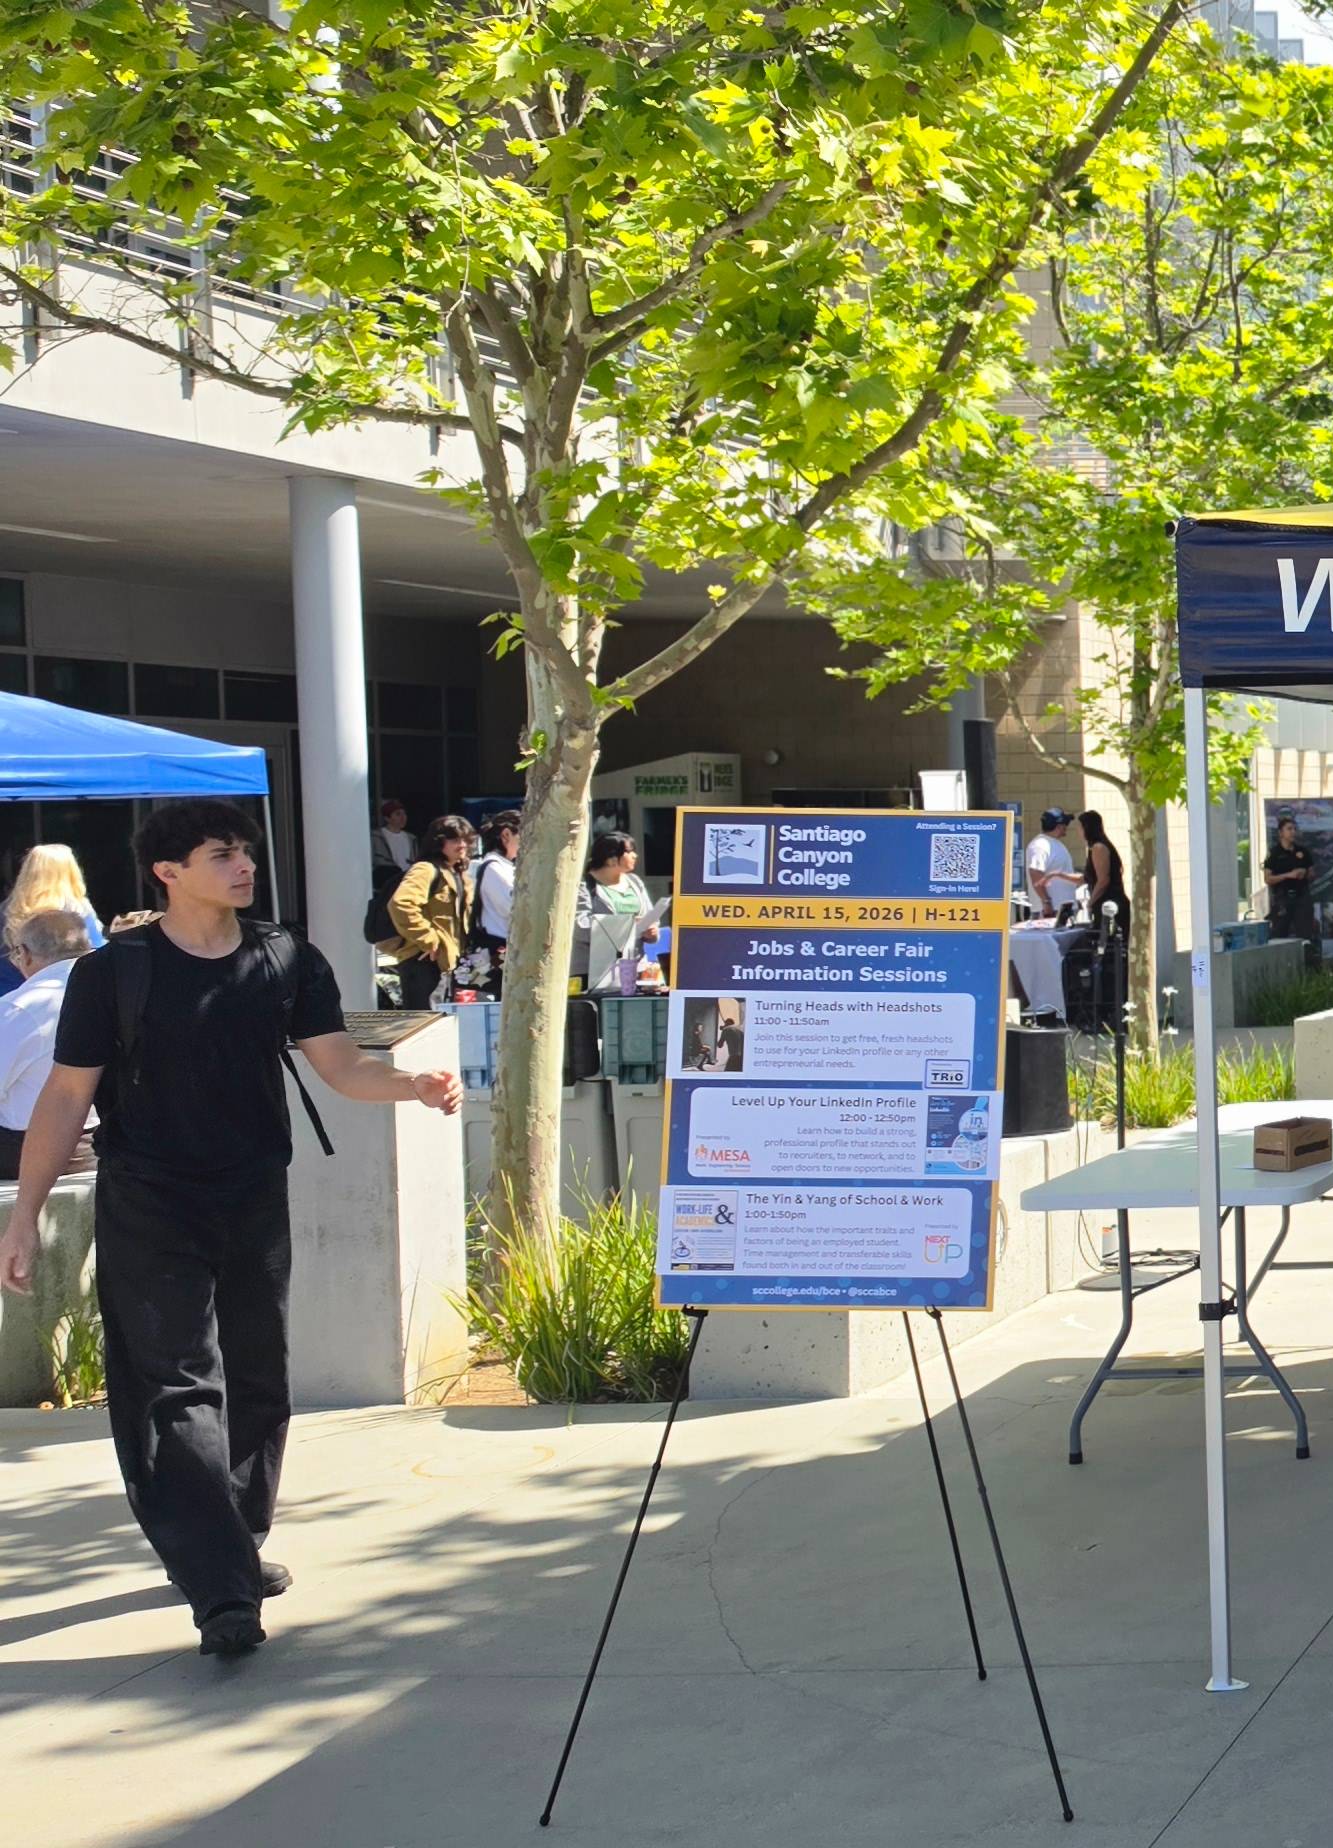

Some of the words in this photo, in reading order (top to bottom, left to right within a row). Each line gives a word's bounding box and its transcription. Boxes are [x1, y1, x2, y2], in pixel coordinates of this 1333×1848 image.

[635, 786, 688, 795] FRIDGE
[916, 822, 956, 832] Attending
[962, 823, 997, 831] Session?
[779, 825, 866, 846] Santiago
[779, 848, 853, 867] Canyon
[777, 869, 850, 890] College
[703, 905, 751, 919] WED.
[758, 906, 815, 919] APRIL
[823, 907, 851, 922] 15,
[858, 907, 903, 921] 2026
[925, 908, 980, 921] H-121
[748, 941, 794, 956] Jobs
[800, 941, 815, 957] &
[821, 942, 889, 957] Career
[894, 942, 933, 957] Fair
[732, 965, 853, 981] Information
[859, 966, 947, 982] Sessions
[756, 1000, 802, 1013] Turning
[806, 1001, 844, 1011] Heads
[847, 1001, 873, 1012] with
[877, 1002, 943, 1013] Headshots
[754, 1017, 781, 1025] 11:00
[789, 1017, 829, 1026] 11:50am
[754, 1034, 774, 1042] Join
[776, 1034, 793, 1042] this
[795, 1034, 828, 1043] session
[830, 1035, 840, 1043] to
[842, 1036, 857, 1045] get
[859, 1034, 880, 1044] free,
[881, 1035, 904, 1043] fresh
[907, 1035, 953, 1044] headshots
[754, 1047, 764, 1055] to
[784, 1047, 798, 1055] for
[799, 1048, 820, 1057] your
[862, 1047, 892, 1057] profile
[905, 1049, 922, 1058] any
[924, 1048, 948, 1057] other
[754, 1059, 824, 1069] entrepreneurial
[826, 1060, 855, 1068] needs.
[732, 1096, 764, 1106] Level
[769, 1097, 785, 1109] Up
[789, 1097, 816, 1107] Your
[876, 1098, 917, 1108] Profile
[840, 1114, 866, 1122] 12:00
[875, 1114, 916, 1124] 12:50pm
[797, 1127, 821, 1135] Learn
[824, 1127, 842, 1135] how
[856, 1127, 877, 1136] build
[886, 1128, 916, 1137] strong,
[764, 1139, 819, 1148] professional
[820, 1139, 849, 1149] profile
[850, 1140, 869, 1148] that
[870, 1140, 900, 1148] stands
[901, 1140, 916, 1148] out
[710, 1150, 751, 1162] MESA
[779, 1151, 788, 1159] to
[790, 1152, 835, 1161] recruiters,
[837, 1152, 846, 1160] to
[848, 1152, 885, 1161] network,
[887, 1152, 905, 1160] and
[771, 1166, 793, 1174] open
[795, 1164, 820, 1173] doors
[854, 1165, 914, 1175] opportunities.
[746, 1194, 768, 1205] The
[772, 1194, 792, 1205] Yin
[795, 1194, 803, 1205] &
[807, 1194, 837, 1208] Yang
[839, 1194, 853, 1205] of
[855, 1194, 897, 1206] School
[900, 1195, 909, 1206] &
[912, 1195, 944, 1206] Work
[676, 1204, 712, 1215] WORK-LIFE
[715, 1204, 735, 1225] &
[745, 1210, 807, 1221] 1:00-1:50pm
[744, 1225, 768, 1234] Learn
[770, 1225, 792, 1234] about
[795, 1225, 813, 1234] how
[815, 1226, 830, 1234] the
[832, 1226, 873, 1236] important
[875, 1226, 897, 1235] traits
[899, 1226, 915, 1235] and
[744, 1237, 774, 1246] factors
[776, 1237, 785, 1246] of
[786, 1238, 809, 1248] being
[823, 1238, 865, 1248] employed
[925, 1235, 951, 1244] NEXT
[744, 1249, 764, 1258] Time
[766, 1250, 820, 1260] management
[825, 1250, 838, 1258] and
[840, 1250, 890, 1259] transferable
[891, 1250, 912, 1259] skills
[924, 1243, 963, 1264] UP
[743, 1261, 767, 1270] found
[769, 1261, 789, 1270] both
[791, 1262, 799, 1270] in
[801, 1262, 816, 1270] and
[818, 1263, 832, 1271] out
[834, 1262, 845, 1271] of
[847, 1262, 860, 1271] the
[861, 1262, 906, 1271] classroom!
[752, 1286, 841, 1298] sccollege.edu/bce
[848, 1287, 897, 1297] @sccabce
